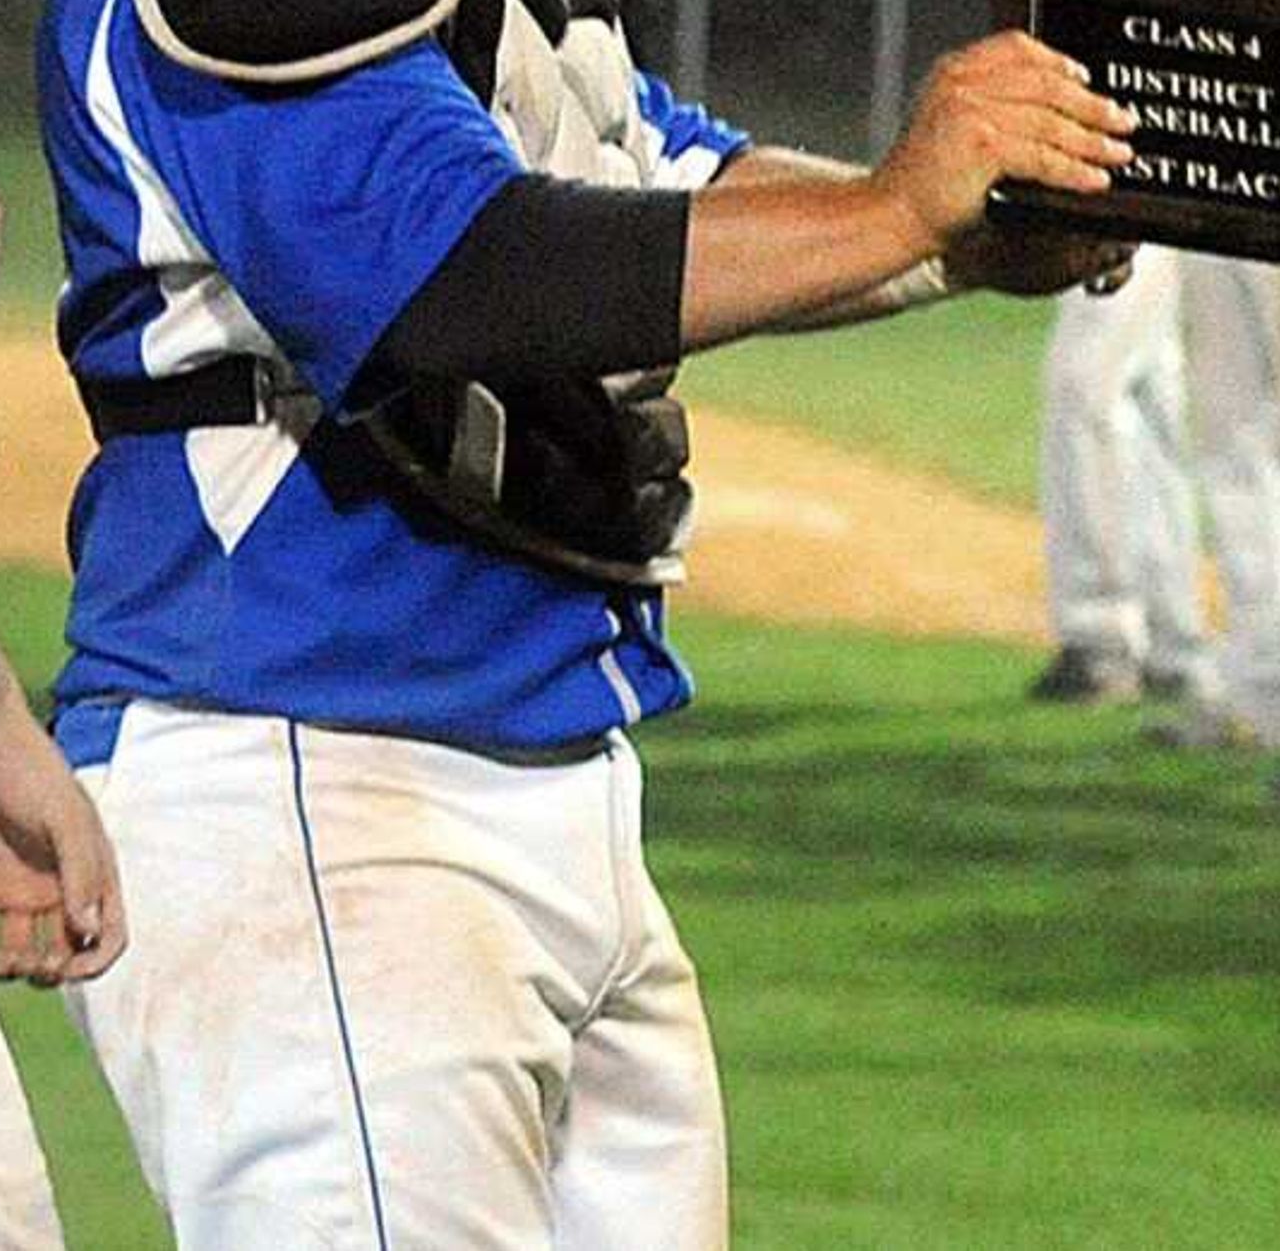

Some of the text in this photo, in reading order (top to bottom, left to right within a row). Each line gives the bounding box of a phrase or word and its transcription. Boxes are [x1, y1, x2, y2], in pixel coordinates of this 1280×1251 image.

[1122, 15, 1261, 60] CLASS 4
[1107, 60, 1275, 113] DISTRICT
